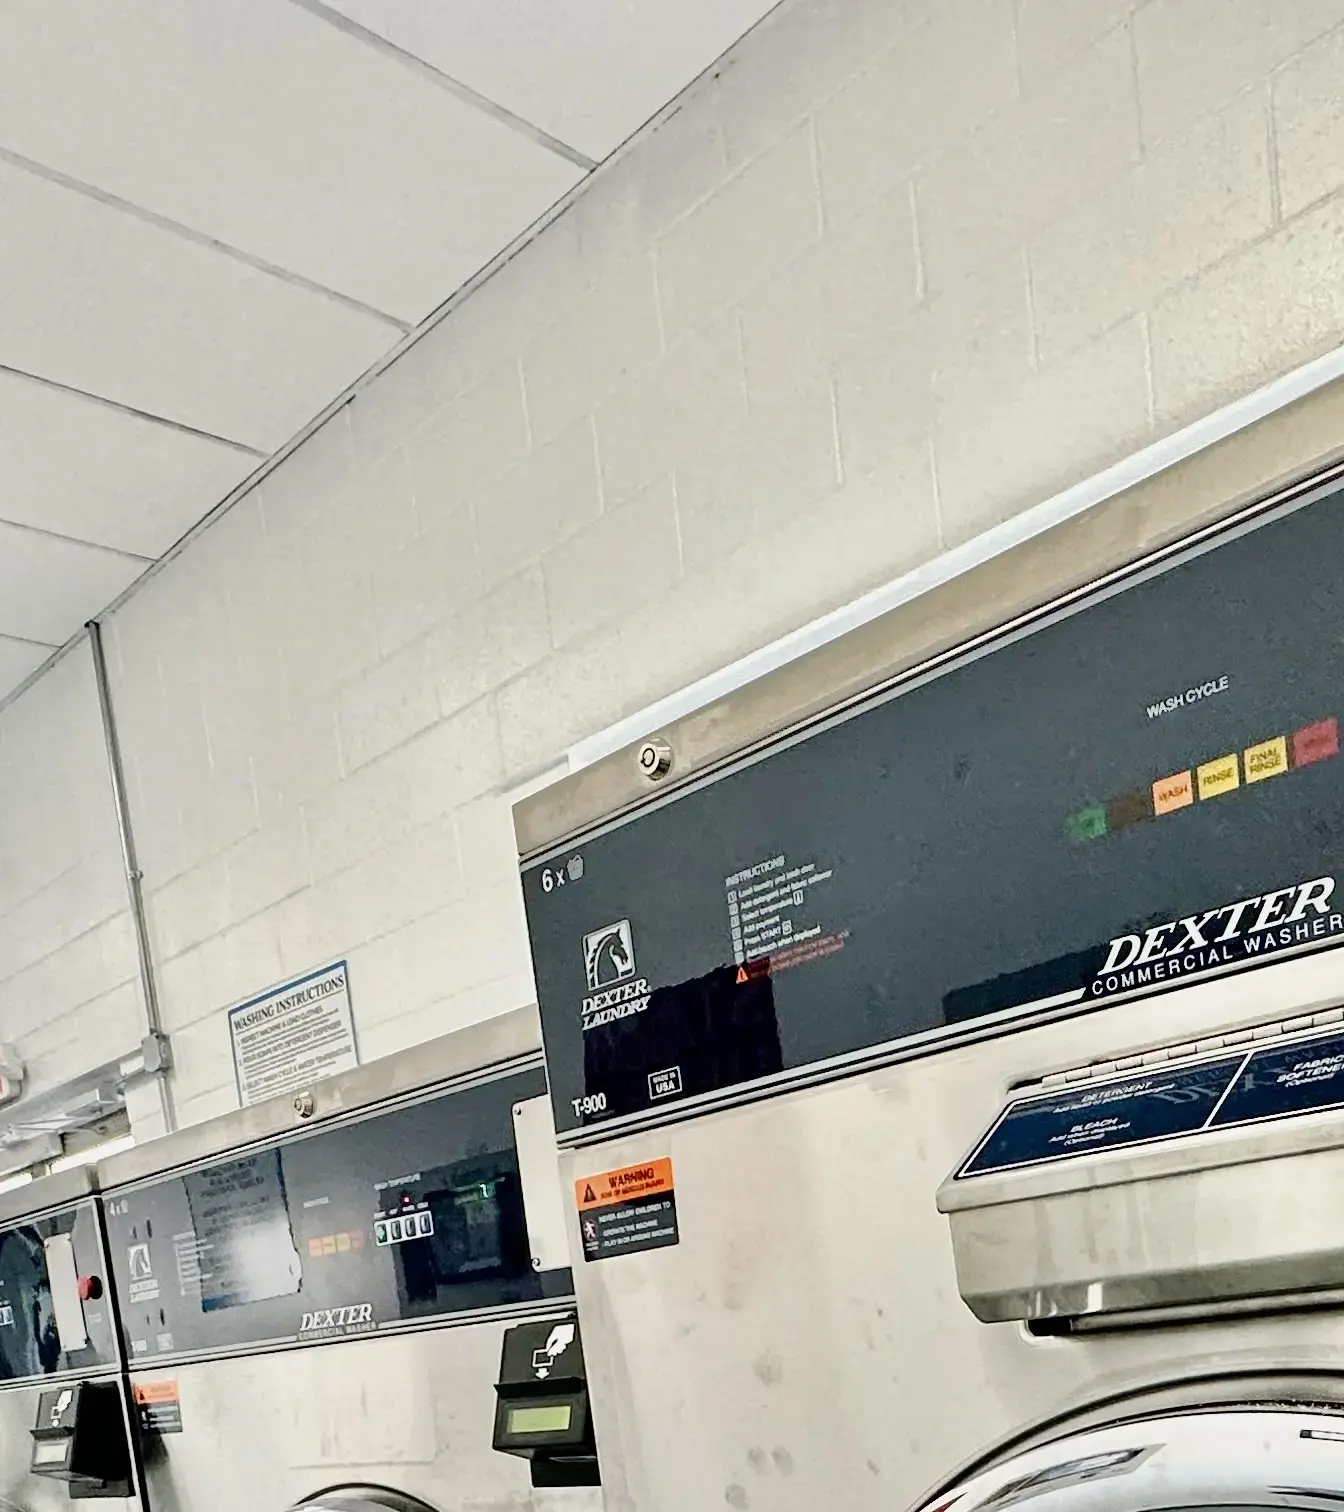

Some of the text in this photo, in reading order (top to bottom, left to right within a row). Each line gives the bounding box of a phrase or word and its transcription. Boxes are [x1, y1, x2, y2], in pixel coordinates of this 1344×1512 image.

[1146, 675, 1230, 719] WASH CYCLE
[1249, 755, 1281, 775] RINSE
[1250, 747, 1278, 763] FINAL
[1202, 767, 1234, 786] RINSE
[1158, 784, 1188, 804] WASH
[725, 855, 785, 887] INSTRUCTIONS
[1097, 876, 1335, 976] DEXTER
[1092, 914, 1344, 996] COMMERCIAL WASHER
[233, 974, 345, 1031] WASHING INSTRUCTIONS
[581, 978, 648, 1016] DEXTER
[582, 995, 652, 1031] LAUNDRY
[656, 1080, 676, 1093] USA
[1081, 1081, 1153, 1103] DETERGENT
[571, 1092, 607, 1117] T-900
[1070, 1117, 1119, 1133] BLEACH
[608, 1167, 655, 1188] WARNING
[300, 1303, 373, 1332] DEXTER
